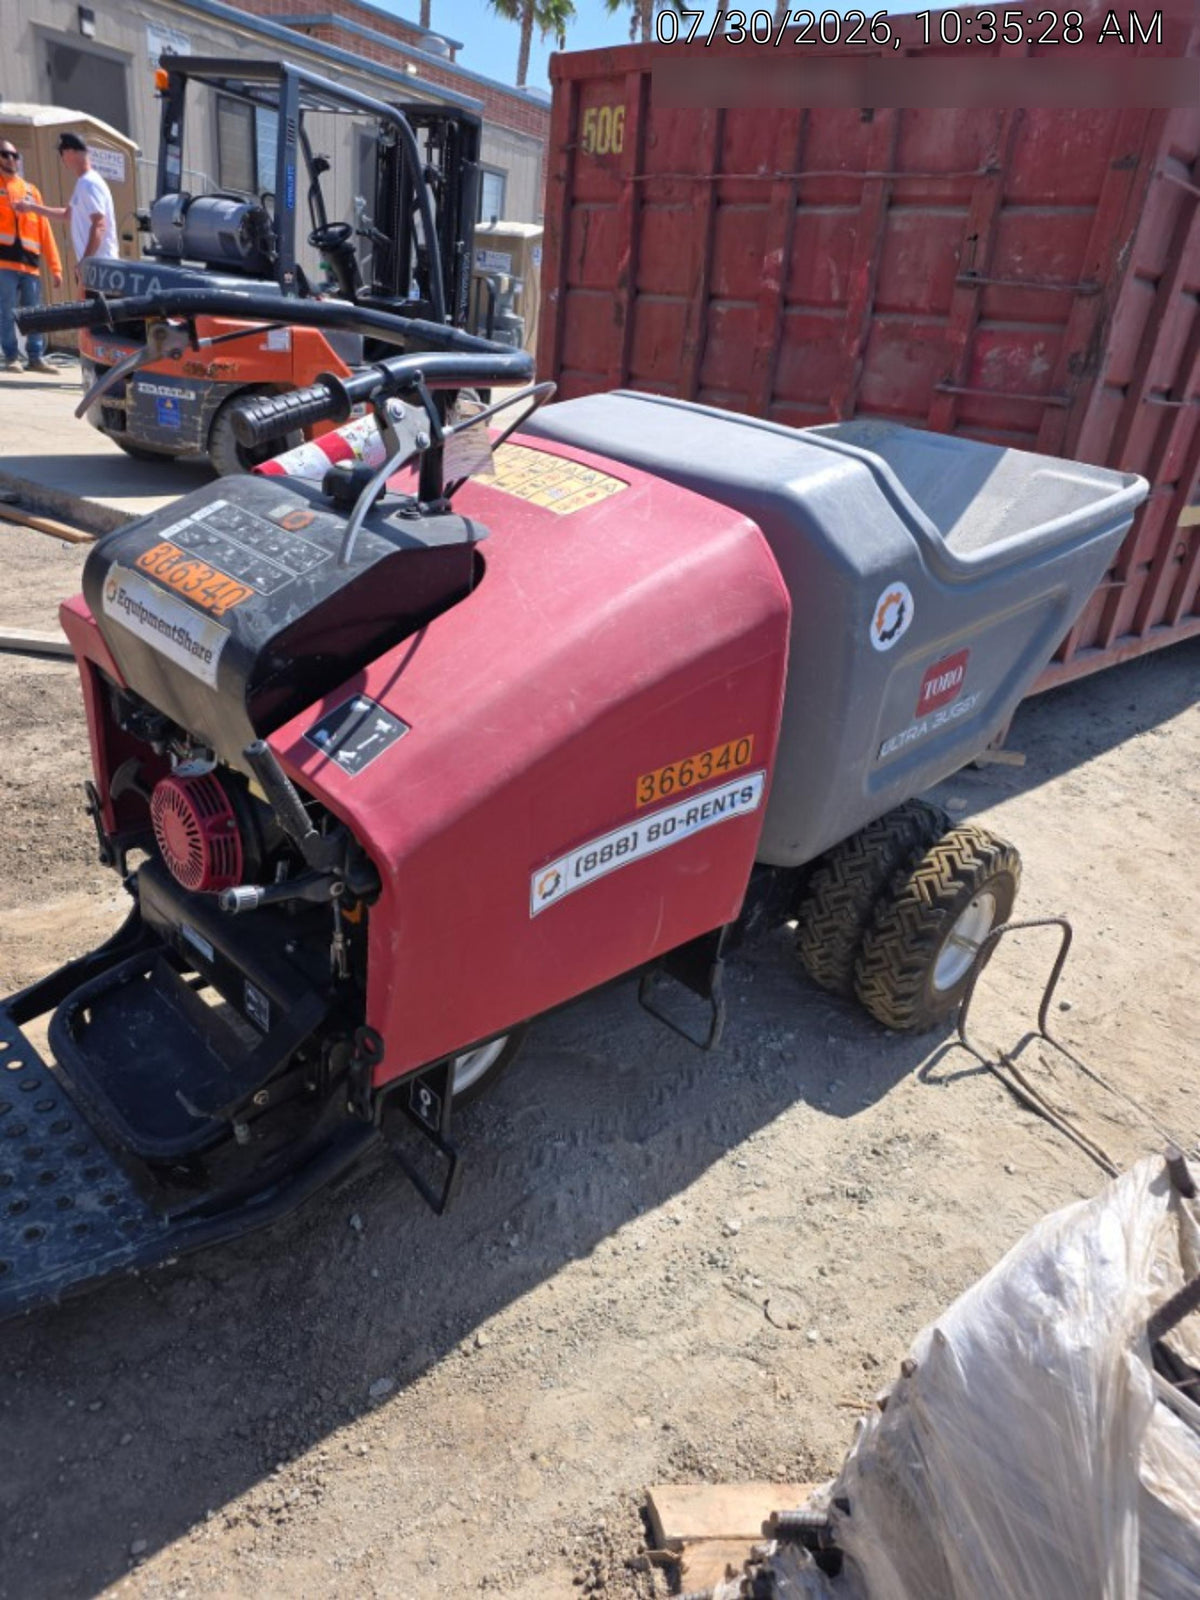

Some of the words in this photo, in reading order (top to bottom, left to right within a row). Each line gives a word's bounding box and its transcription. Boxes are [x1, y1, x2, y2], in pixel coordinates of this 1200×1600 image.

[581, 104, 625, 155] 506
[116, 587, 213, 666] EquipmentShare
[923, 665, 964, 701] TORO
[879, 720, 929, 759] ULTRA
[638, 737, 753, 806] 366340
[574, 834, 639, 878] (888)
[646, 785, 755, 841] 80-RENTS
